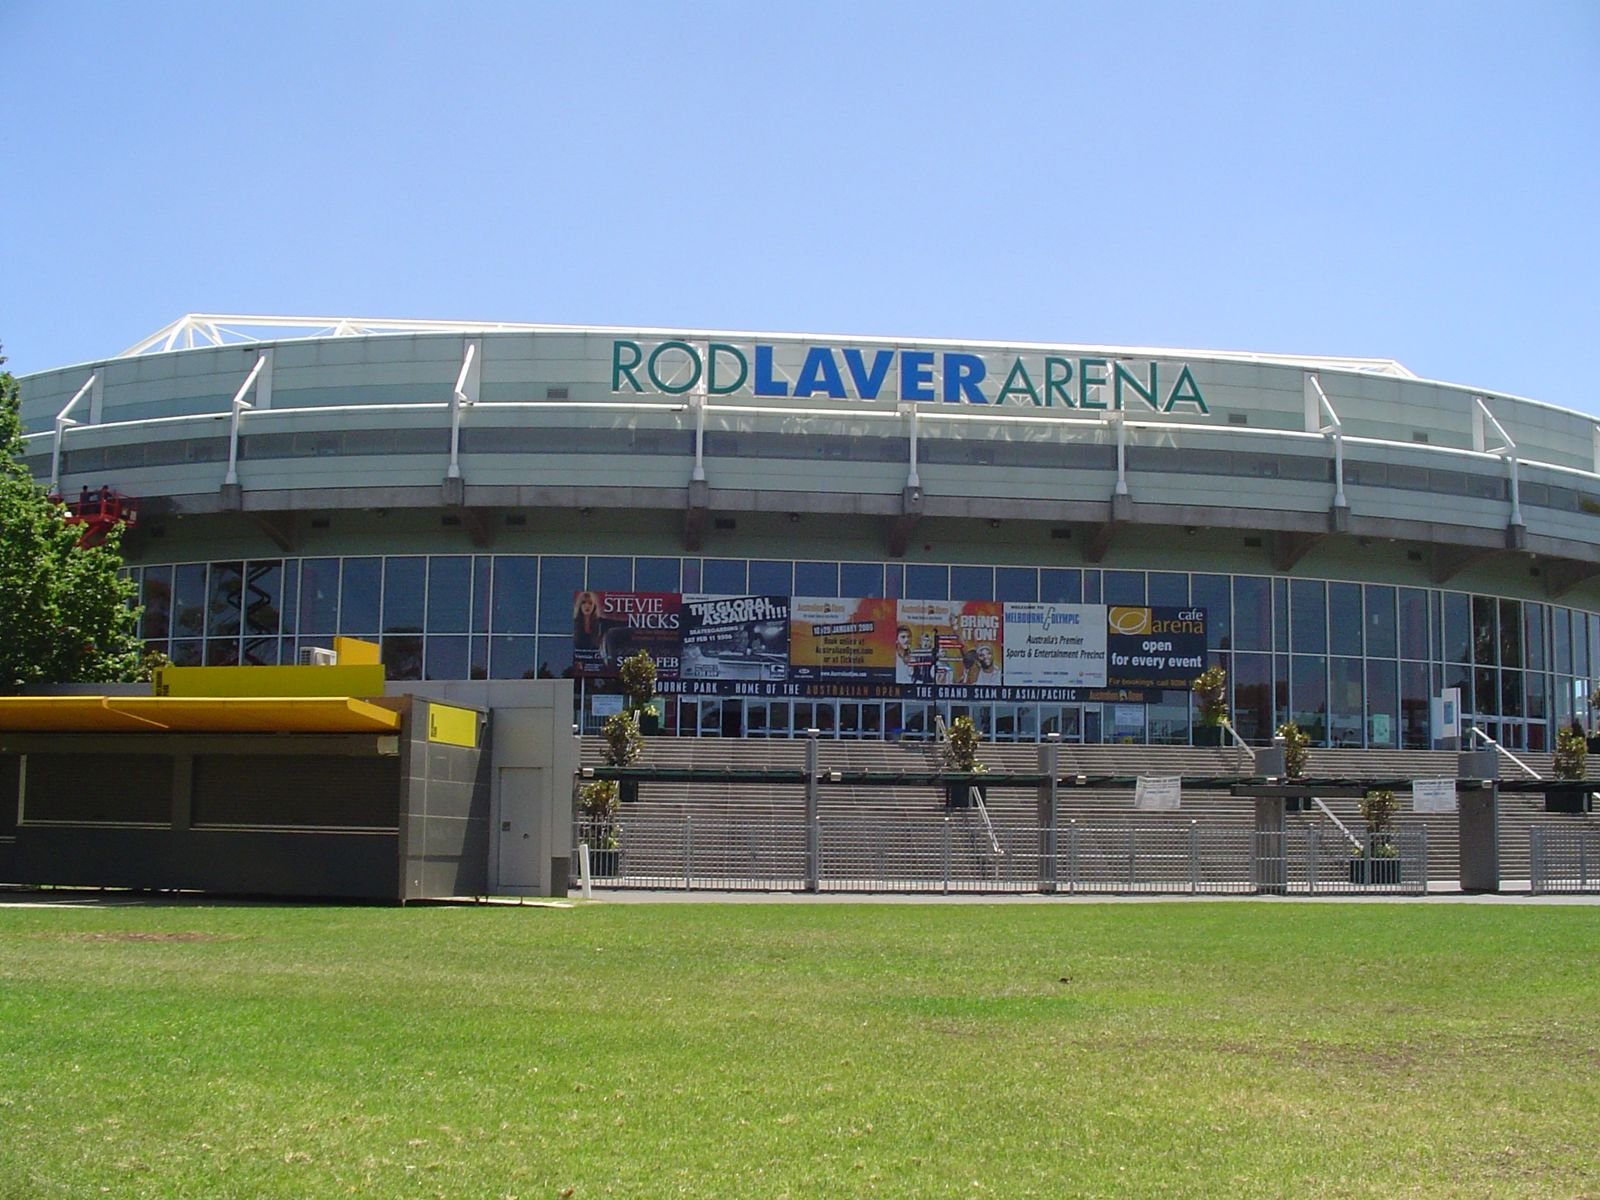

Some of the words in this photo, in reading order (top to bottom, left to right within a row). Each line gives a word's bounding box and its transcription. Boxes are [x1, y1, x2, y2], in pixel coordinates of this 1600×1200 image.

[611, 340, 749, 396] ROD
[753, 345, 988, 406] LAVER
[994, 355, 1211, 414] ARENA
[604, 598, 663, 613] STEVIE
[689, 603, 716, 616] THE
[716, 597, 771, 614] GLOBAL
[1005, 612, 1044, 624] MELBOURNE
[1051, 613, 1079, 624] OLYMPIC
[1178, 608, 1203, 620] cafe
[628, 614, 680, 629] NICKS
[960, 615, 999, 628] BRING
[1152, 620, 1204, 634] arena
[832, 624, 857, 634] JANUARY
[962, 628, 973, 640] IT
[974, 628, 997, 641] ON!
[1026, 635, 1058, 645] Australia's
[1059, 635, 1084, 645] Premier
[1006, 648, 1026, 659] Sports
[1033, 649, 1079, 658] Entertainment
[1080, 650, 1105, 659] Precinct
[1142, 641, 1172, 653] open
[656, 656, 679, 668] FEB
[1111, 652, 1129, 665] for
[1131, 656, 1165, 669] every
[1168, 656, 1202, 667] event
[693, 682, 717, 693] PARK
[735, 683, 759, 694] HOME
[766, 683, 776, 694] OF
[783, 684, 800, 695] THE
[806, 684, 869, 696] AUSTRALIAN
[875, 685, 900, 696] OPEN
[916, 686, 932, 697] THE
[938, 687, 967, 698] GRAND
[974, 688, 997, 698] SLAM
[1002, 688, 1012, 699] OF
[1016, 689, 1076, 700] ASIA/PACIFIC
